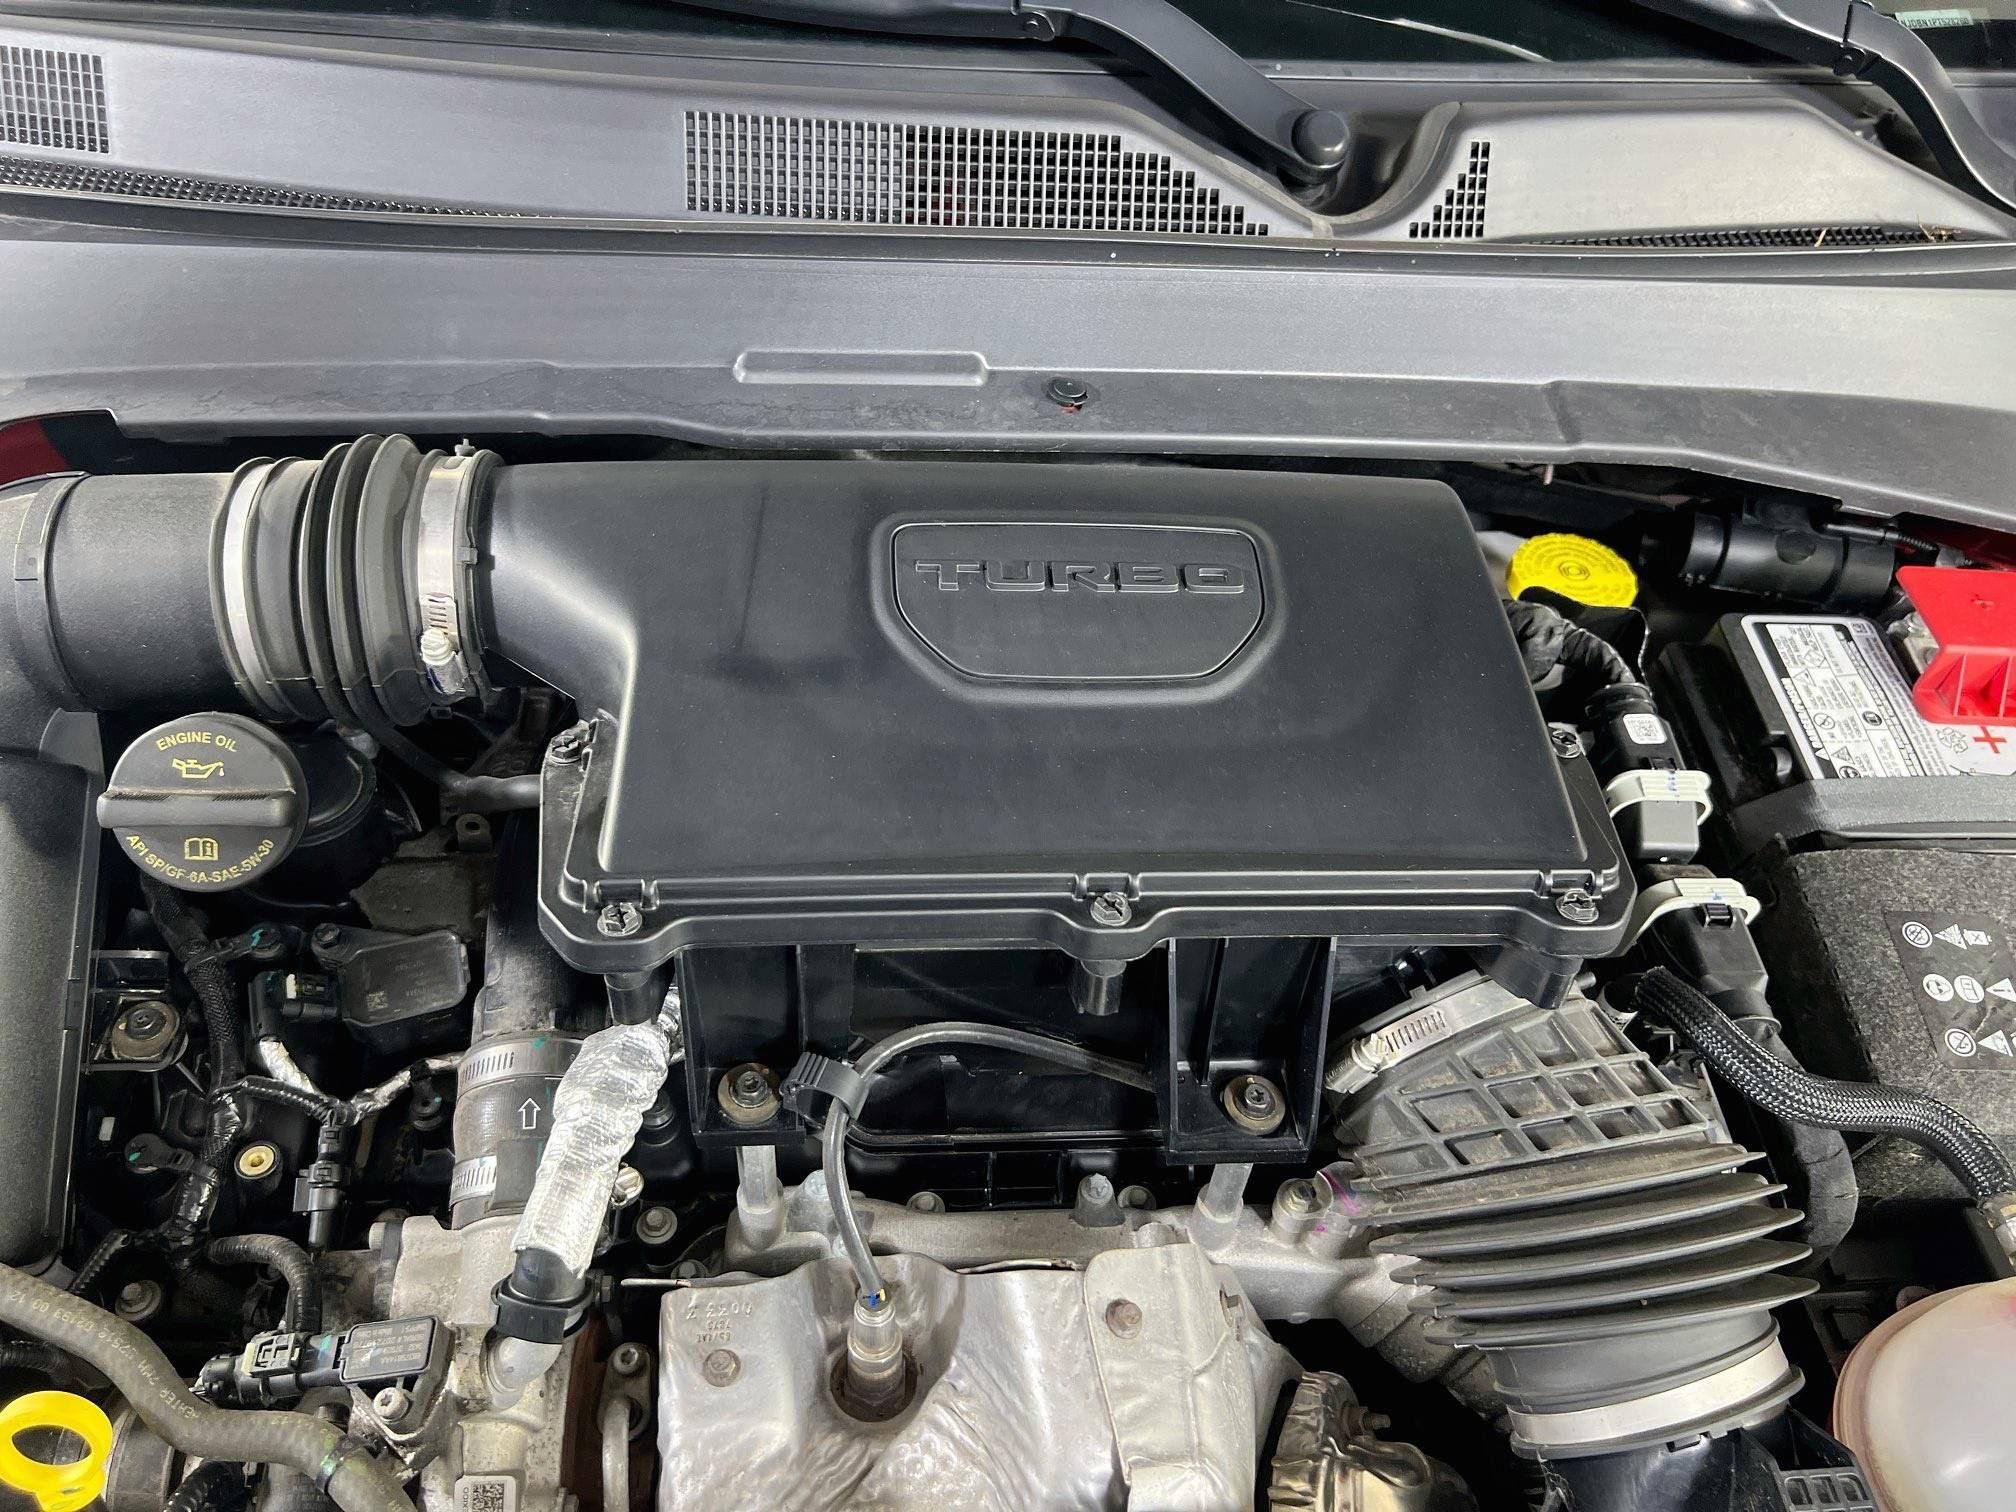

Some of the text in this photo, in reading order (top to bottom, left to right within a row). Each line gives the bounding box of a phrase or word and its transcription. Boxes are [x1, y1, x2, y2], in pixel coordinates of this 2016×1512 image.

[915, 560, 1245, 593] TURBO
[155, 731, 240, 753] ENGINE OIL
[126, 833, 275, 883] API SP/GF-6A-SAE-5W-30
